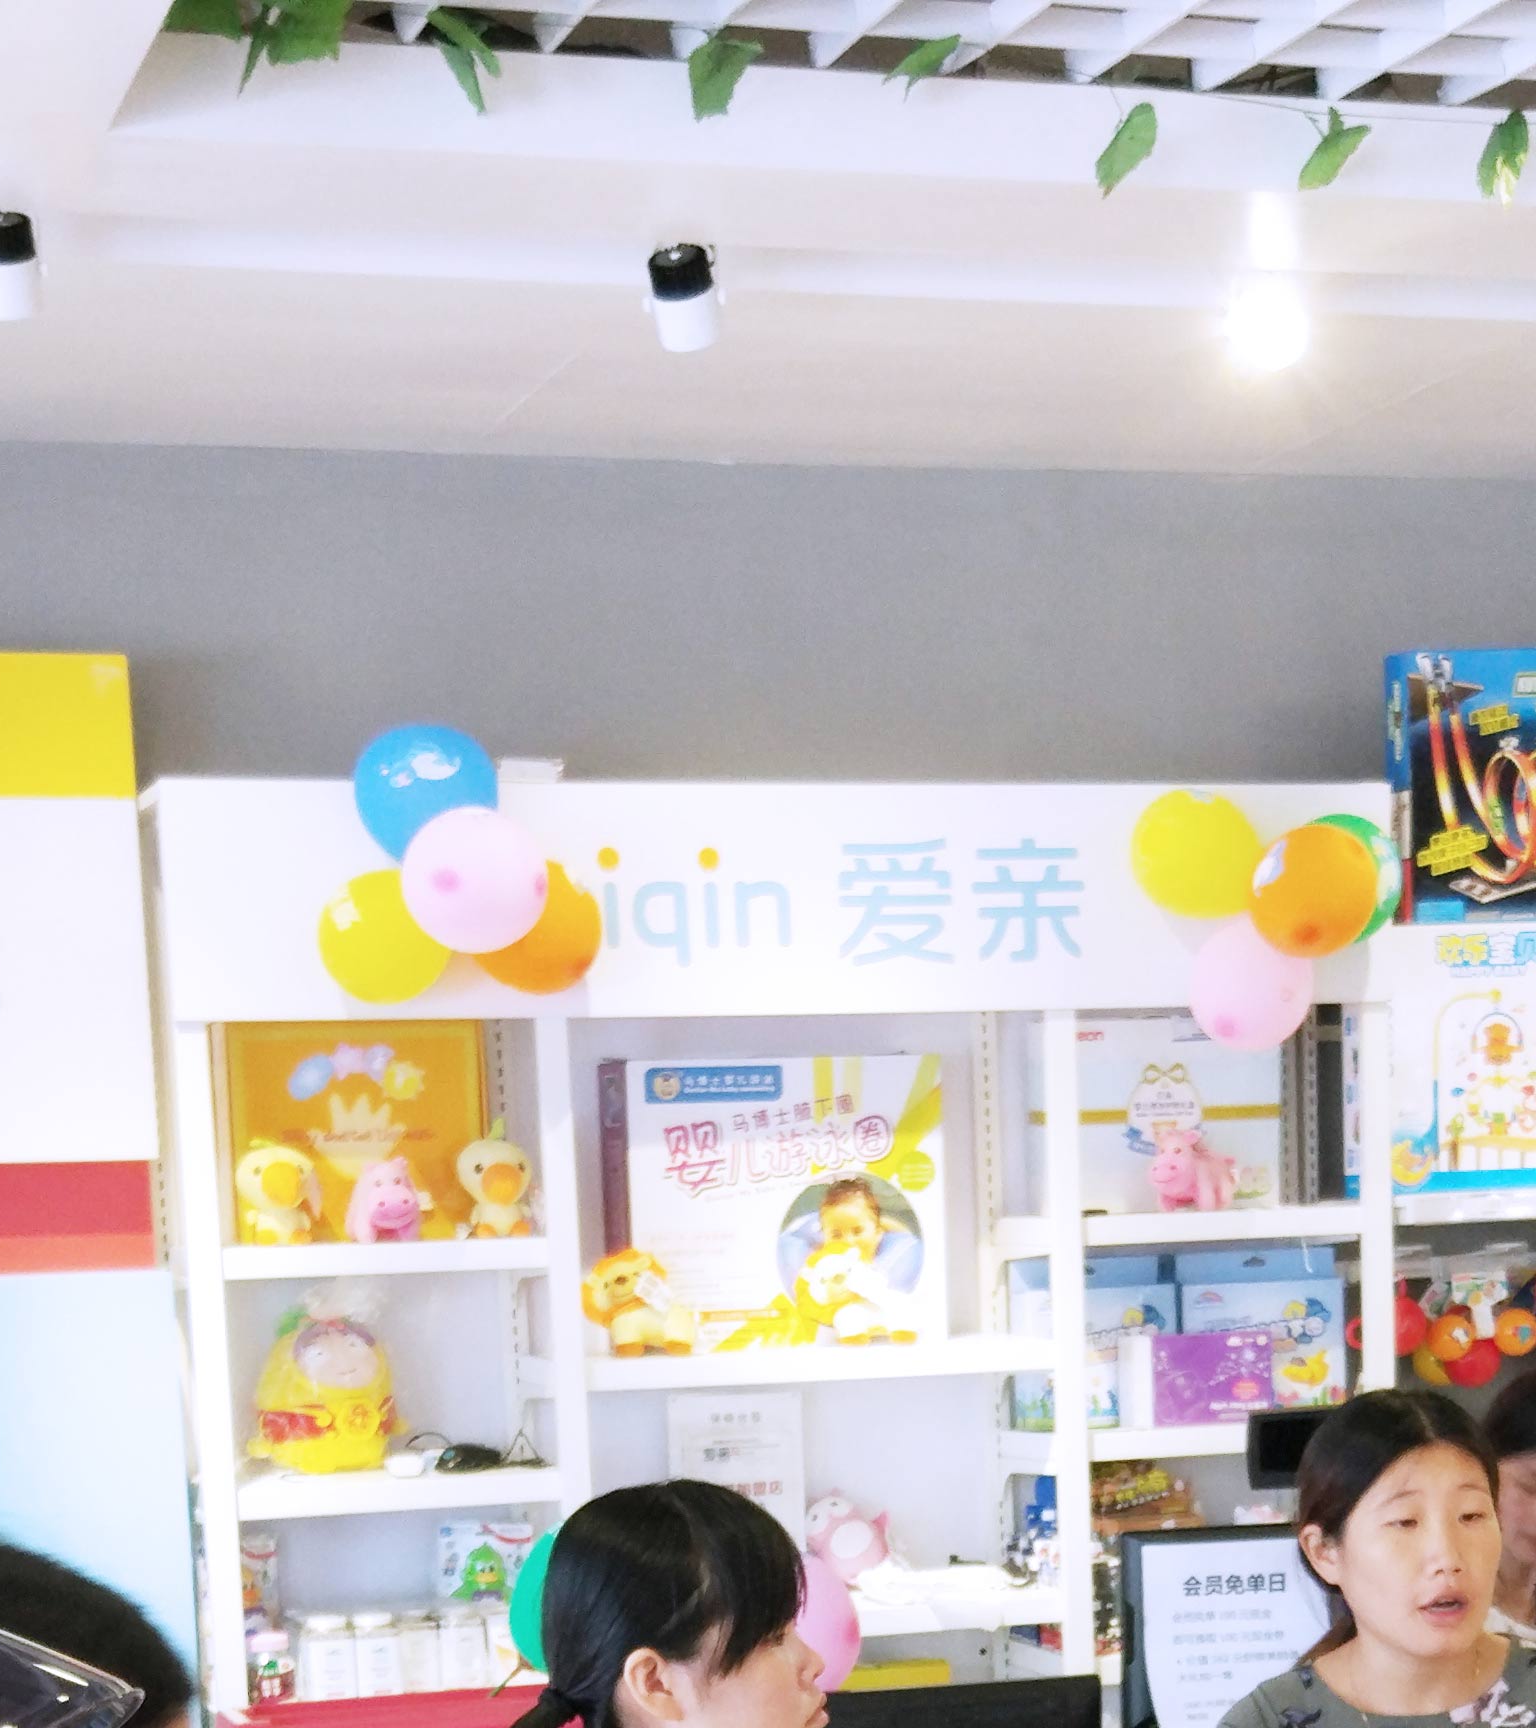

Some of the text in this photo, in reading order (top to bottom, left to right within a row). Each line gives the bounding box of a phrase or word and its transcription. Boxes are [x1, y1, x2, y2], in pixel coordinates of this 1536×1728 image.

[597, 847, 792, 966] iqin
[838, 837, 1086, 966] 爱亲
[721, 1480, 784, 1496] 加盟店
[1183, 1572, 1287, 1596] 会员免单日
